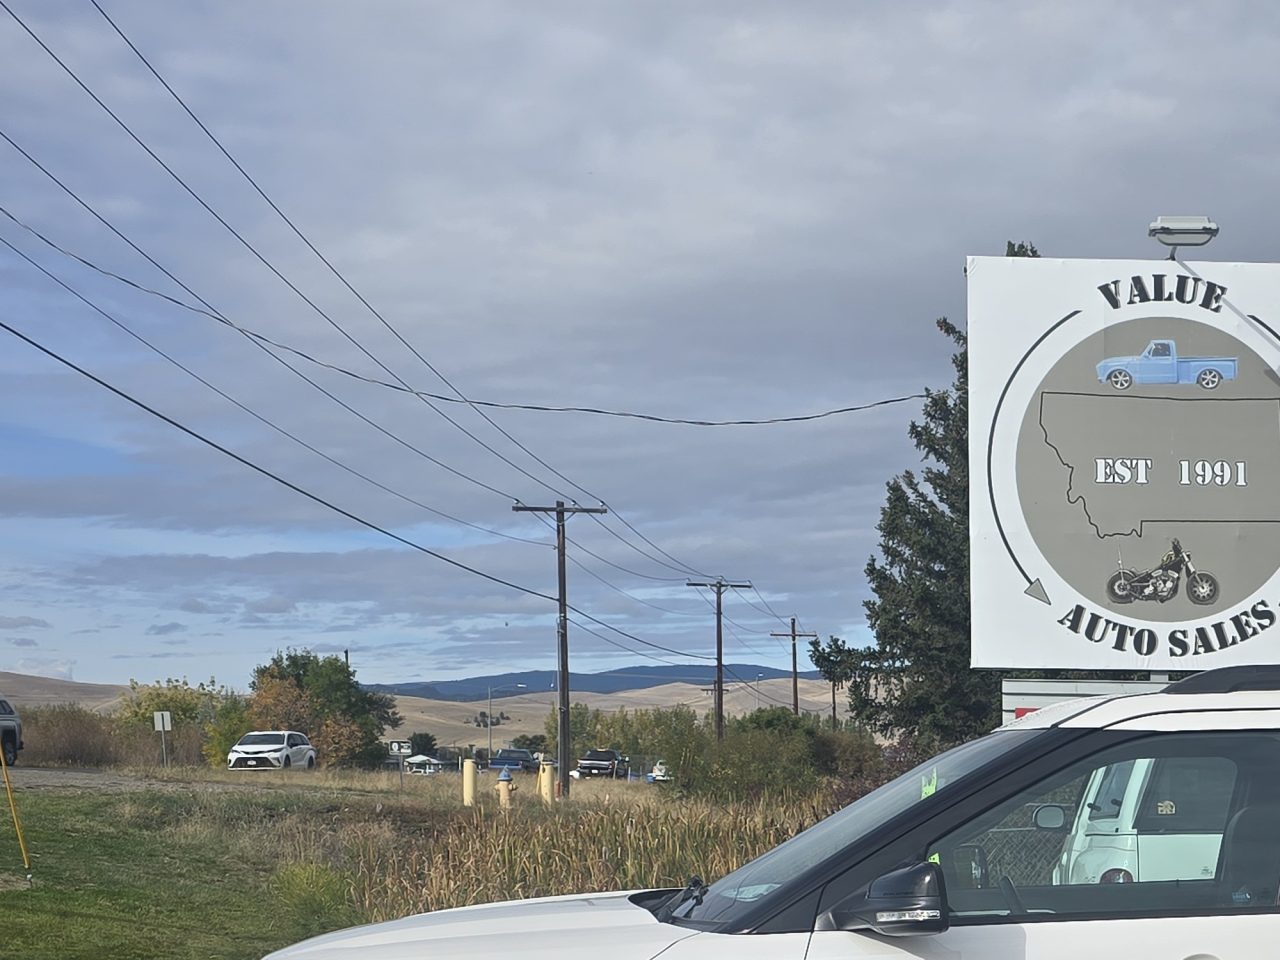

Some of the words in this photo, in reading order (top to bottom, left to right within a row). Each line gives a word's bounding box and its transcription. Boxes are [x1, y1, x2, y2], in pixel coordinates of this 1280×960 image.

[1098, 274, 1227, 313] VALUE
[1094, 457, 1152, 485] EST
[1179, 459, 1248, 486] 1991
[1057, 603, 1159, 657] AUTO
[1167, 599, 1277, 657] SALES
